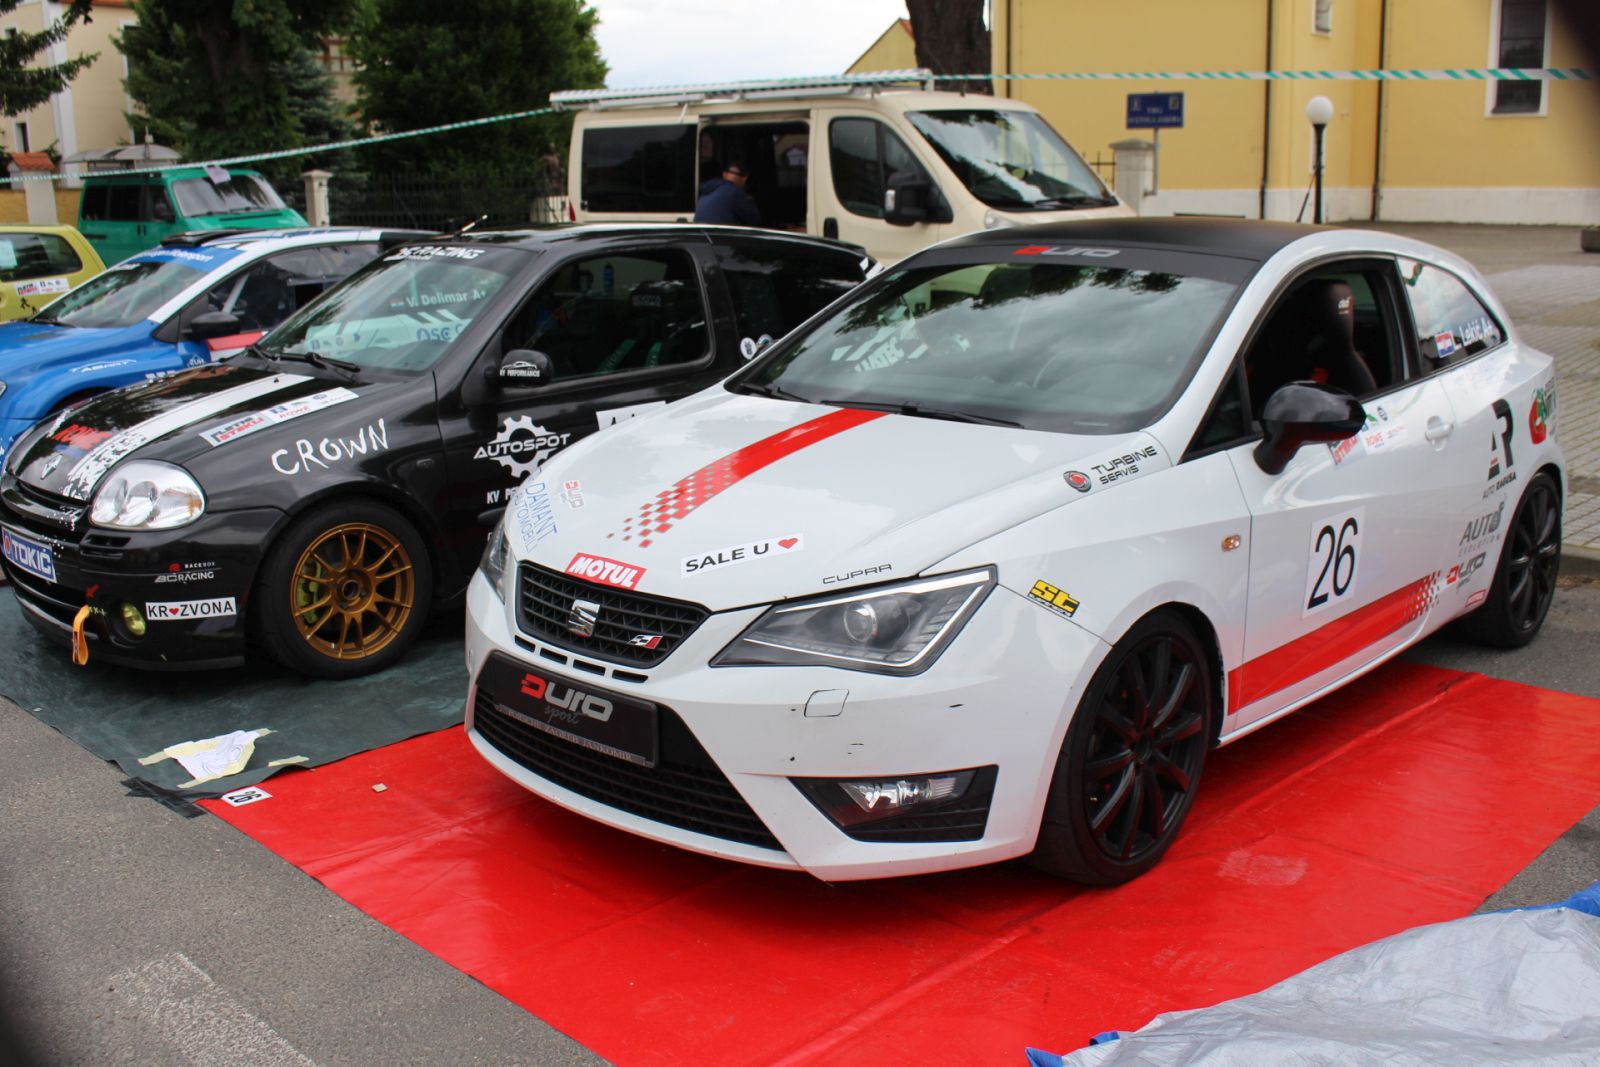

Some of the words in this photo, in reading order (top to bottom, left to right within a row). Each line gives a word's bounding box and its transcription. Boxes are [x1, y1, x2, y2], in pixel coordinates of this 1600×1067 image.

[406, 297, 419, 308] V.
[421, 292, 468, 306] Delimar
[473, 289, 486, 301] A+
[271, 418, 389, 475] CROWN
[473, 433, 572, 460] AUTOSPOT
[1090, 445, 1158, 475] TURBINE
[1099, 464, 1139, 485] SERVIS
[486, 490, 500, 504] KV
[568, 556, 638, 588] MOTUL
[685, 548, 746, 573] SALE
[753, 543, 770, 556] U
[1307, 517, 1358, 610] 26
[822, 563, 893, 585] CUPRA
